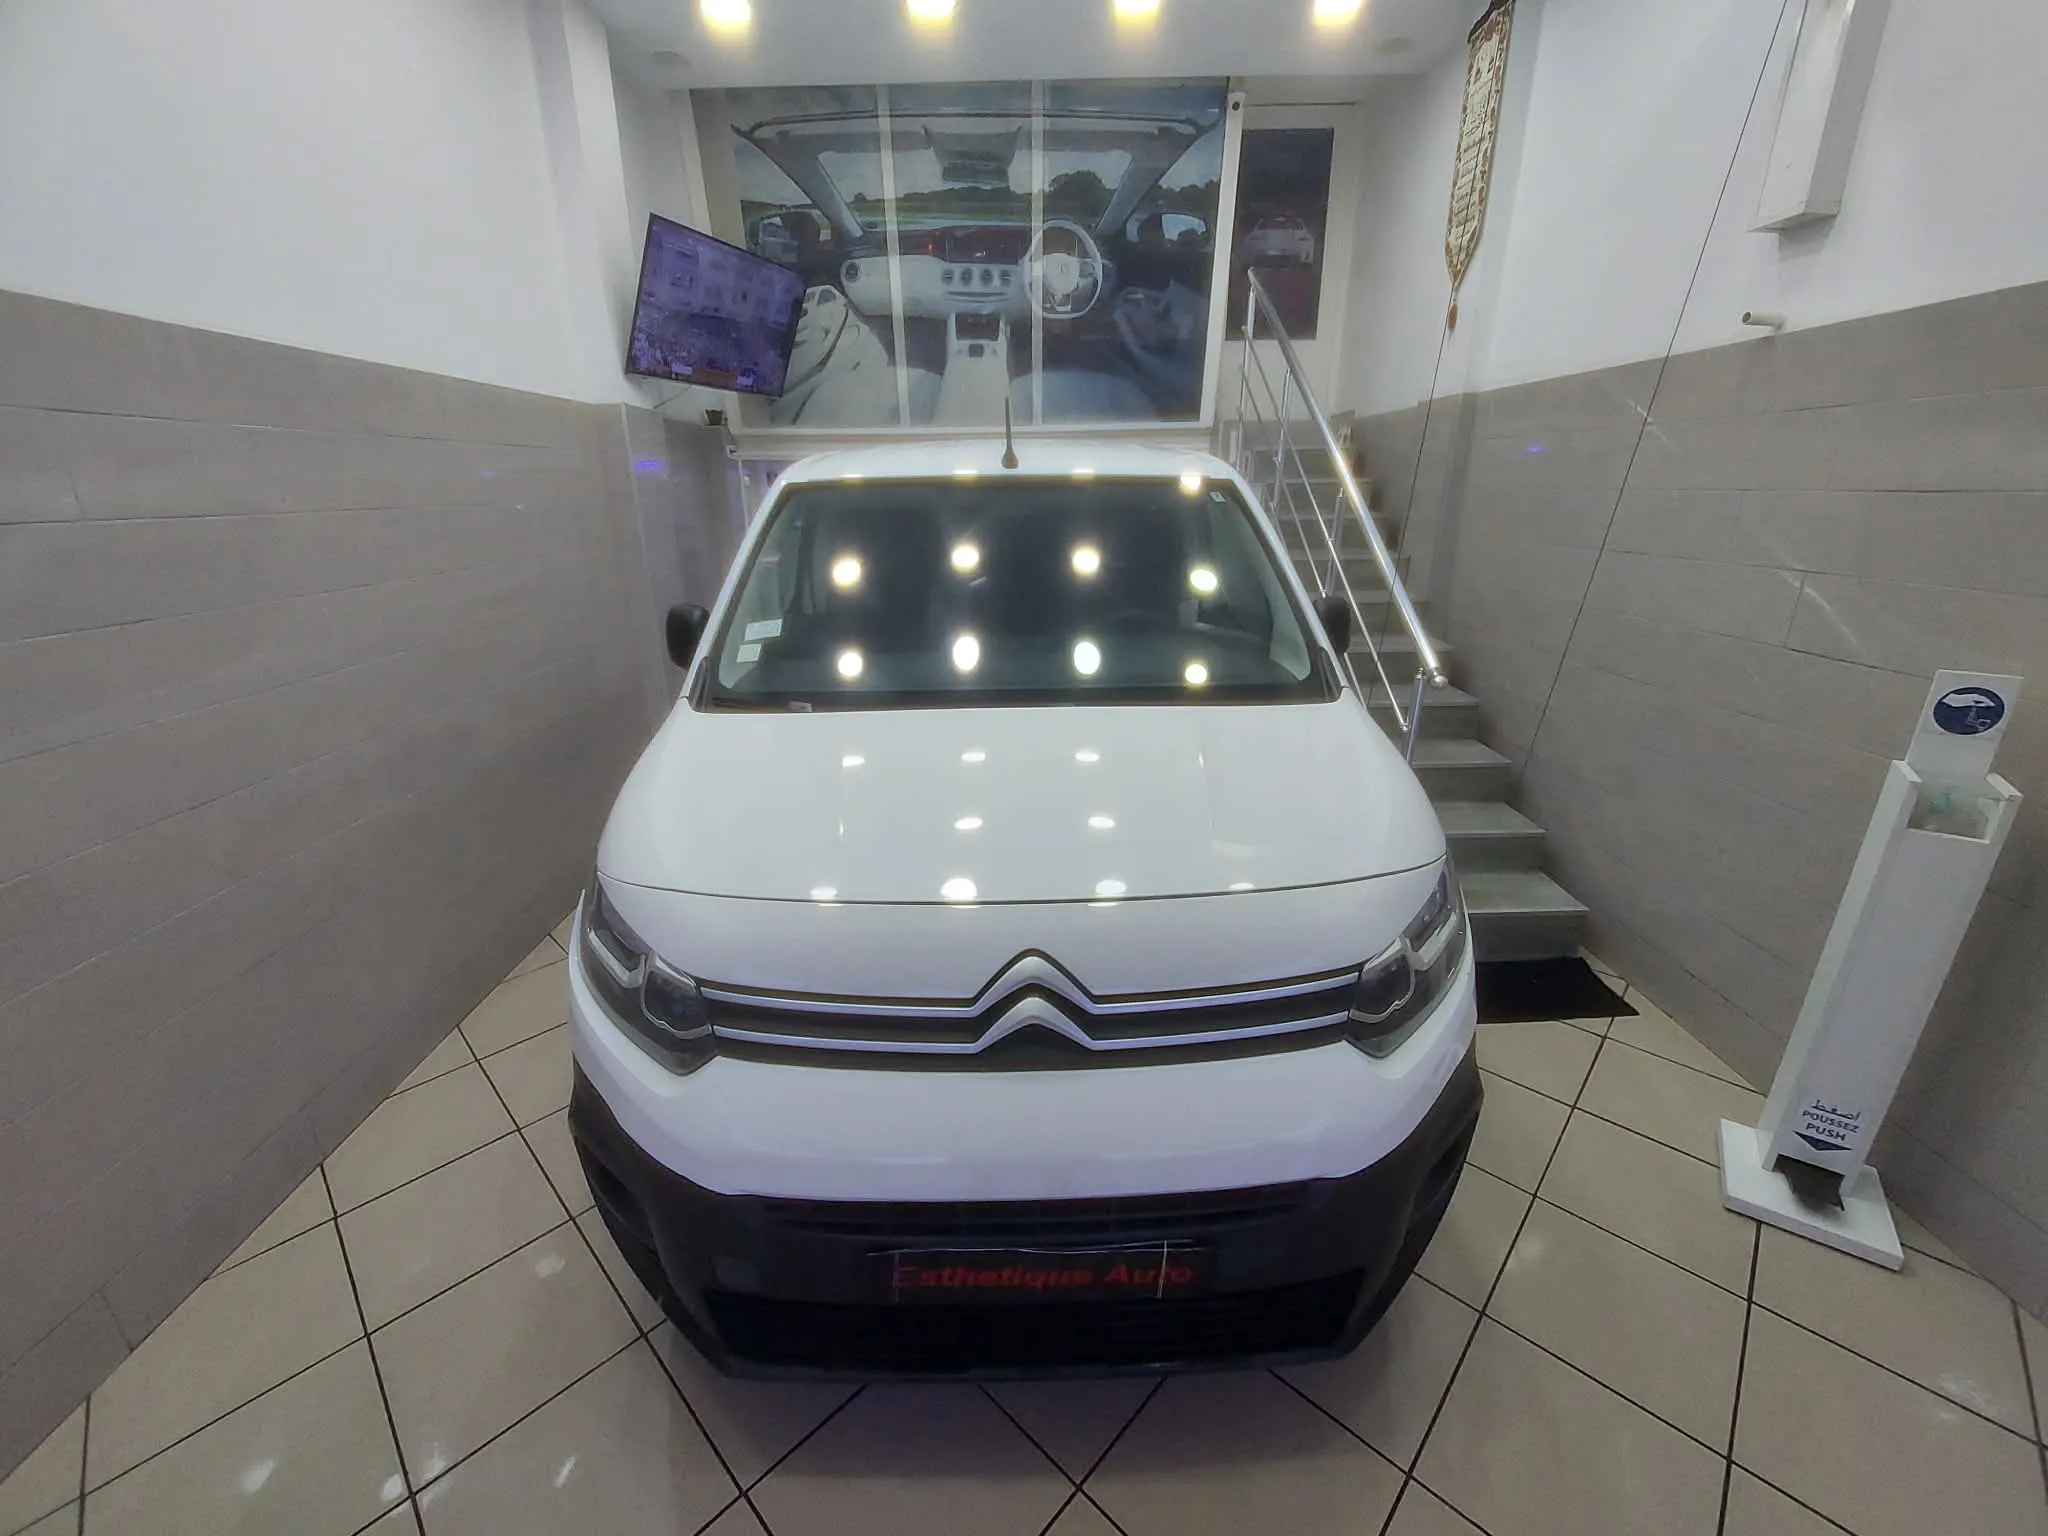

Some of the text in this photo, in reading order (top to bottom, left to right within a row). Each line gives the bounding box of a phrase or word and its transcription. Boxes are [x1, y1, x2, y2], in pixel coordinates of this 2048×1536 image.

[1802, 1110, 1860, 1133] POUSSEZ
[1805, 1122, 1846, 1141] PUSH
[893, 1262, 1195, 1289] Esthetique Auto
